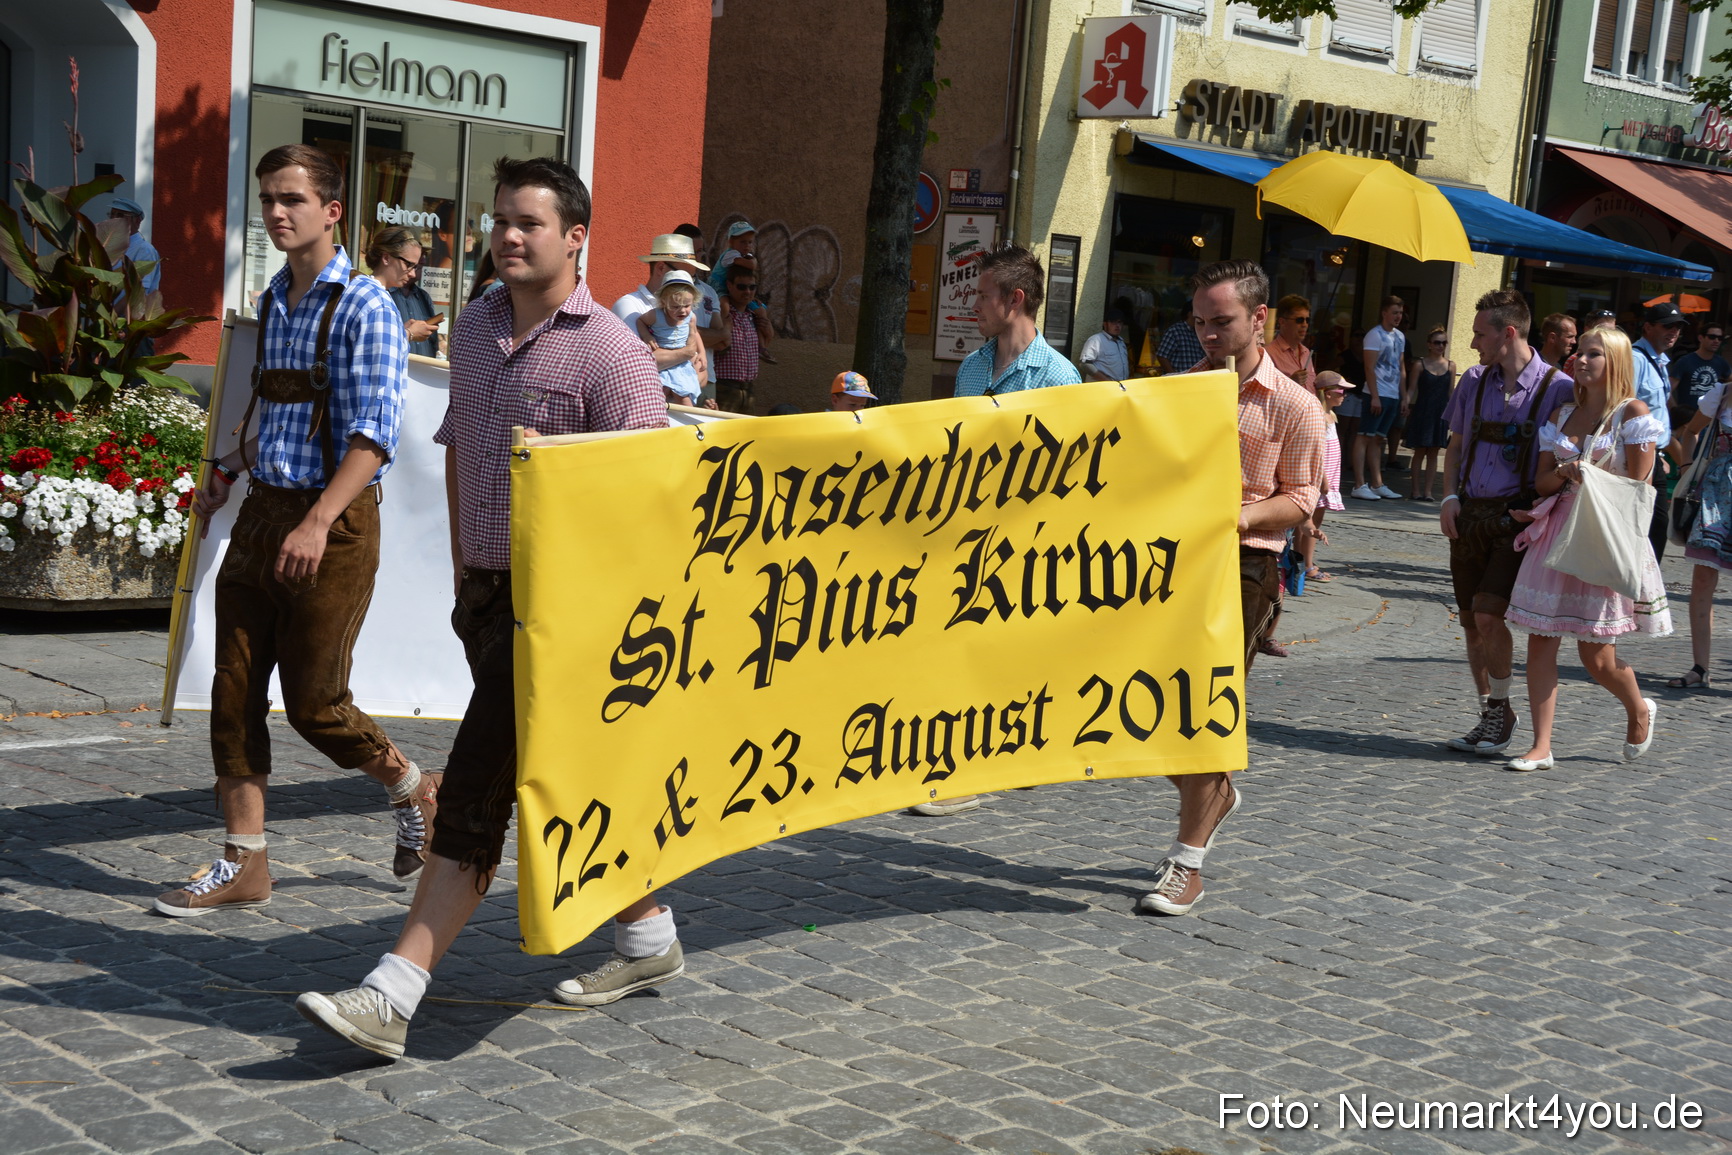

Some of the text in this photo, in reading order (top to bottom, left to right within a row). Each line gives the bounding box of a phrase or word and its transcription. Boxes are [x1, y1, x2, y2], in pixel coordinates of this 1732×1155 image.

[1190, 79, 1437, 160] STADT APOTHEKE
[1622, 119, 1681, 144] METZGEREI
[950, 193, 1003, 207] Bockwirtsgasse
[423, 280, 450, 289] Stärke für
[941, 265, 984, 287] VENEZ
[685, 414, 1121, 582] Hasenheider
[602, 521, 1181, 724] St. Pius Kirwa
[542, 664, 1241, 912] 22. & 23. August 2015
